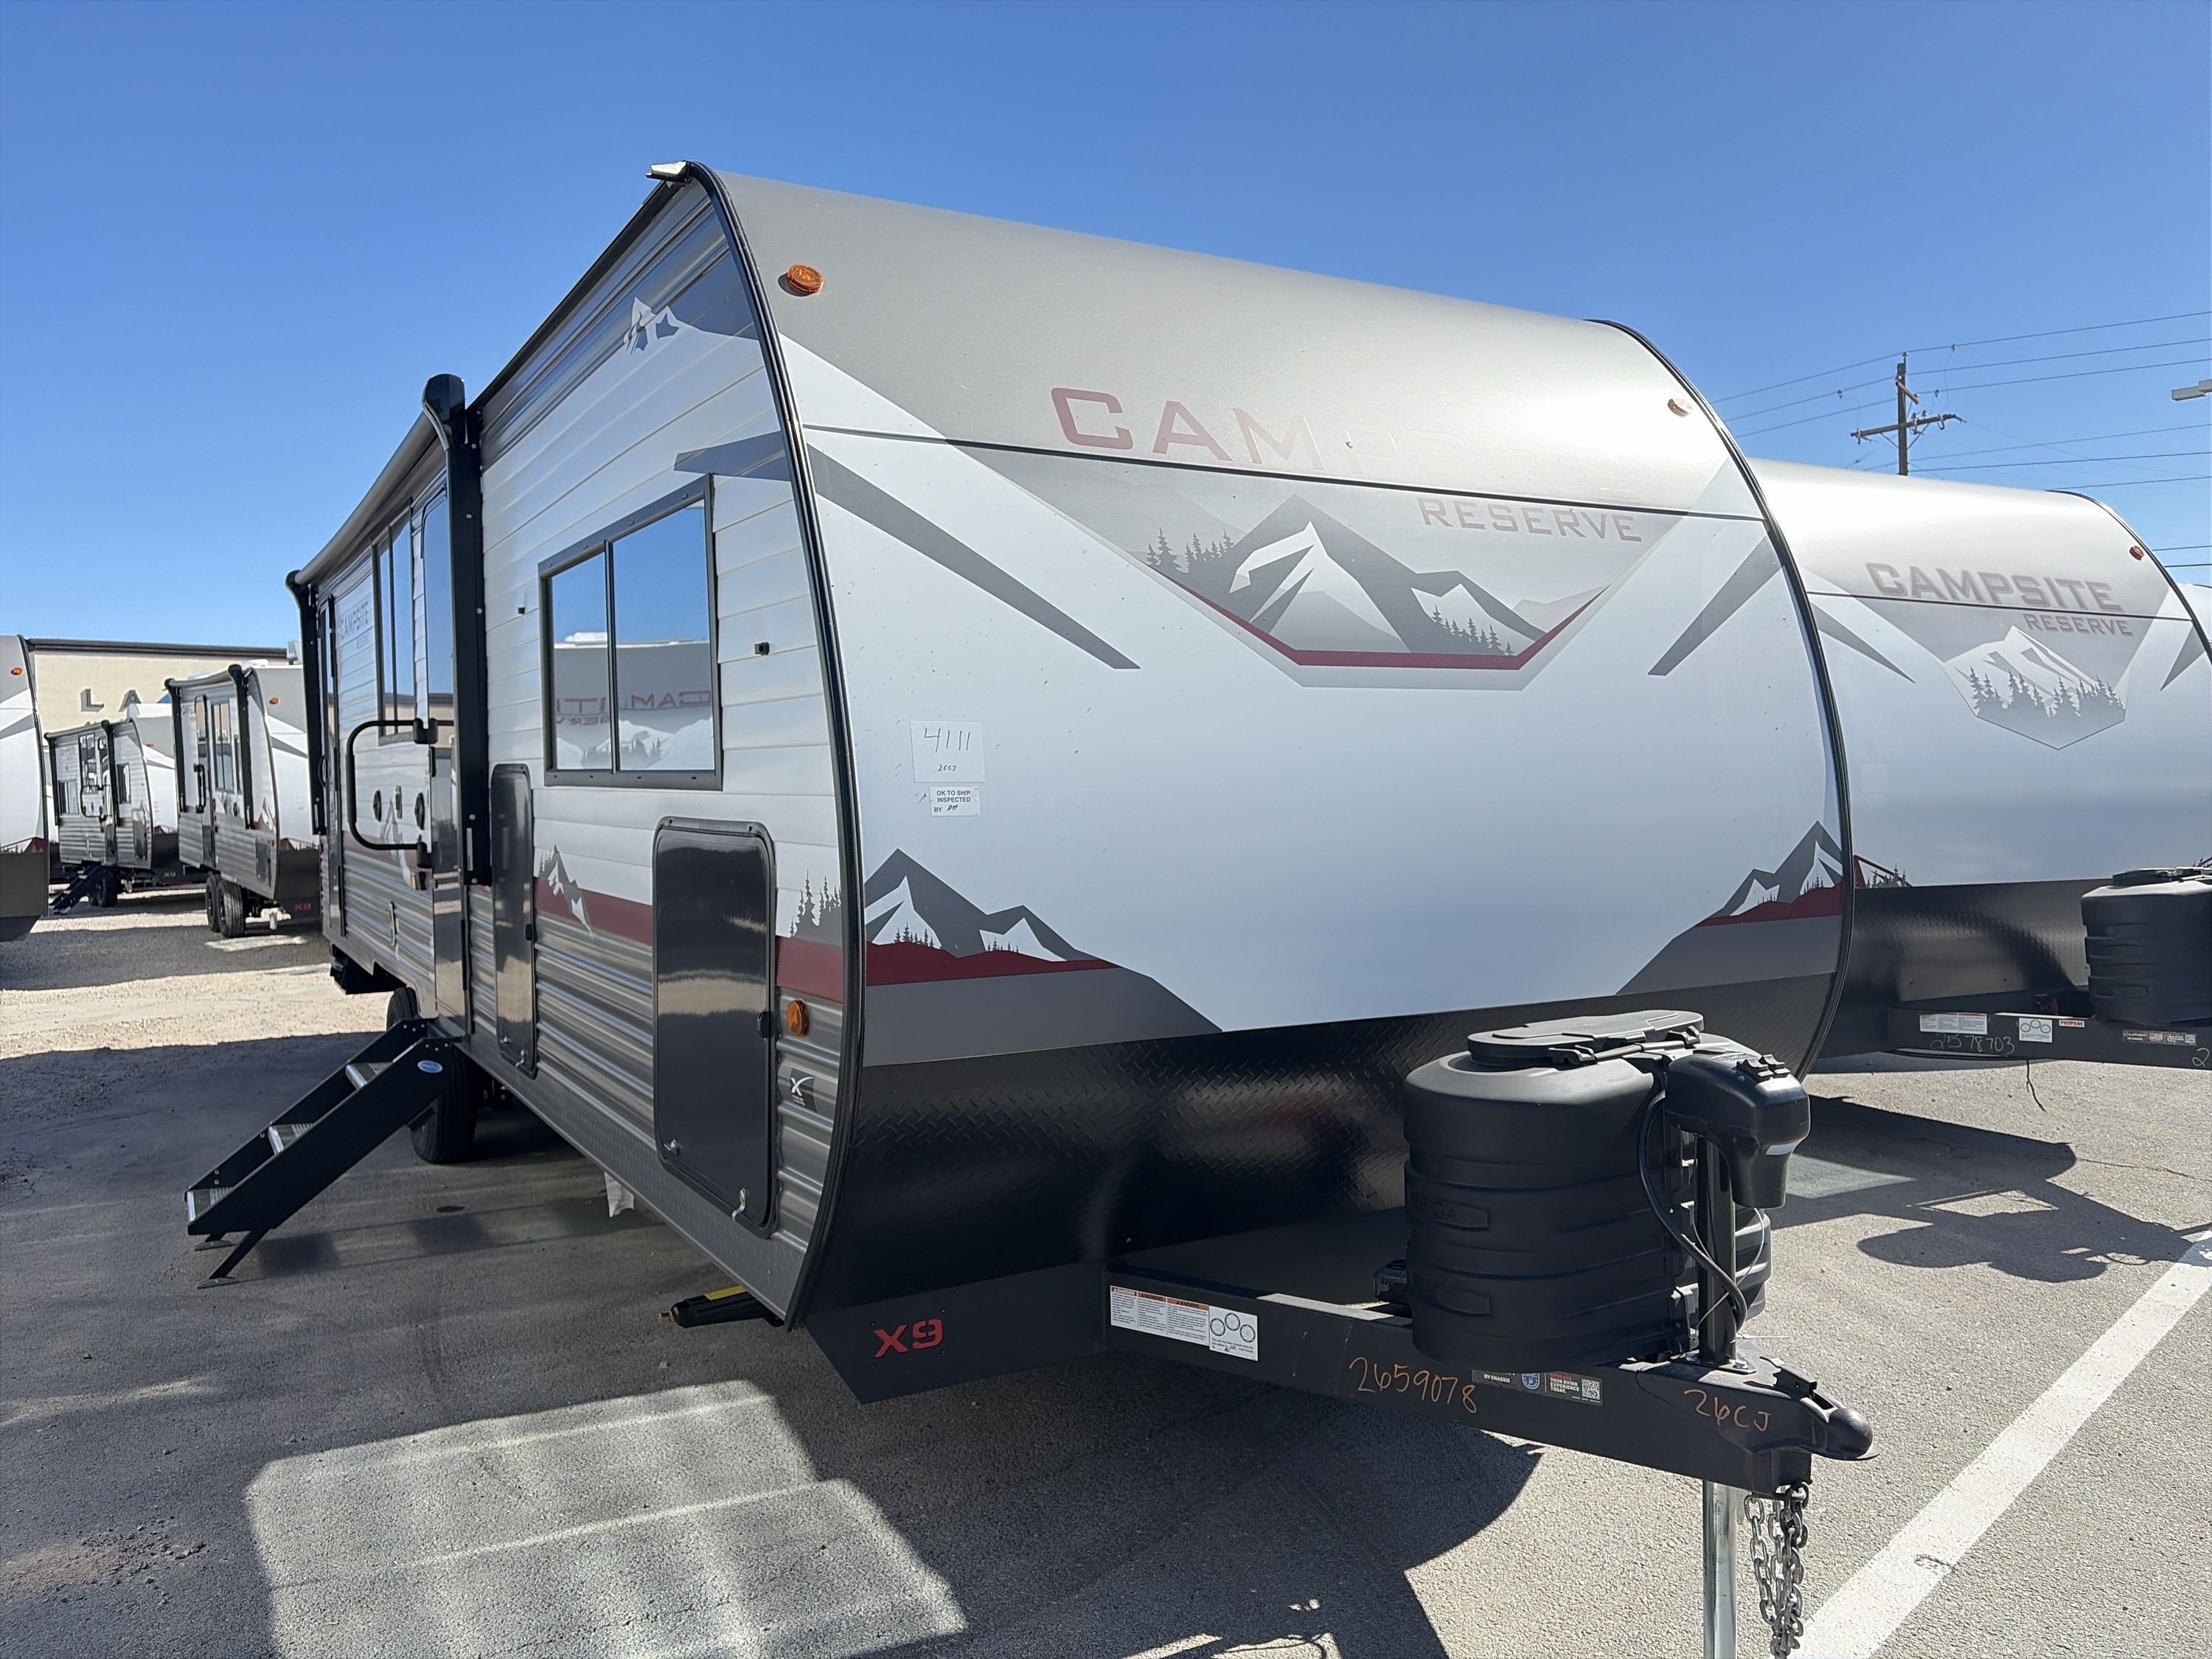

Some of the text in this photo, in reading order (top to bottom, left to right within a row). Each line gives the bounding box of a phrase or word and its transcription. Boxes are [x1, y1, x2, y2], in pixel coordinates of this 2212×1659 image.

[1418, 497, 1644, 543] RESERVE
[1865, 562, 2125, 613] CAMPSITE
[2023, 613, 2134, 638] RESERVE
[924, 727, 971, 753] 4111
[1117, 1288, 1136, 1296] DANGER
[873, 1317, 944, 1359] X9
[1349, 1356, 1478, 1413] 2659078
[1491, 1375, 1511, 1383] CHASSIS
[1550, 1382, 1580, 1392] EXPERIENCE
[1683, 1388, 1772, 1432] 26CJ
